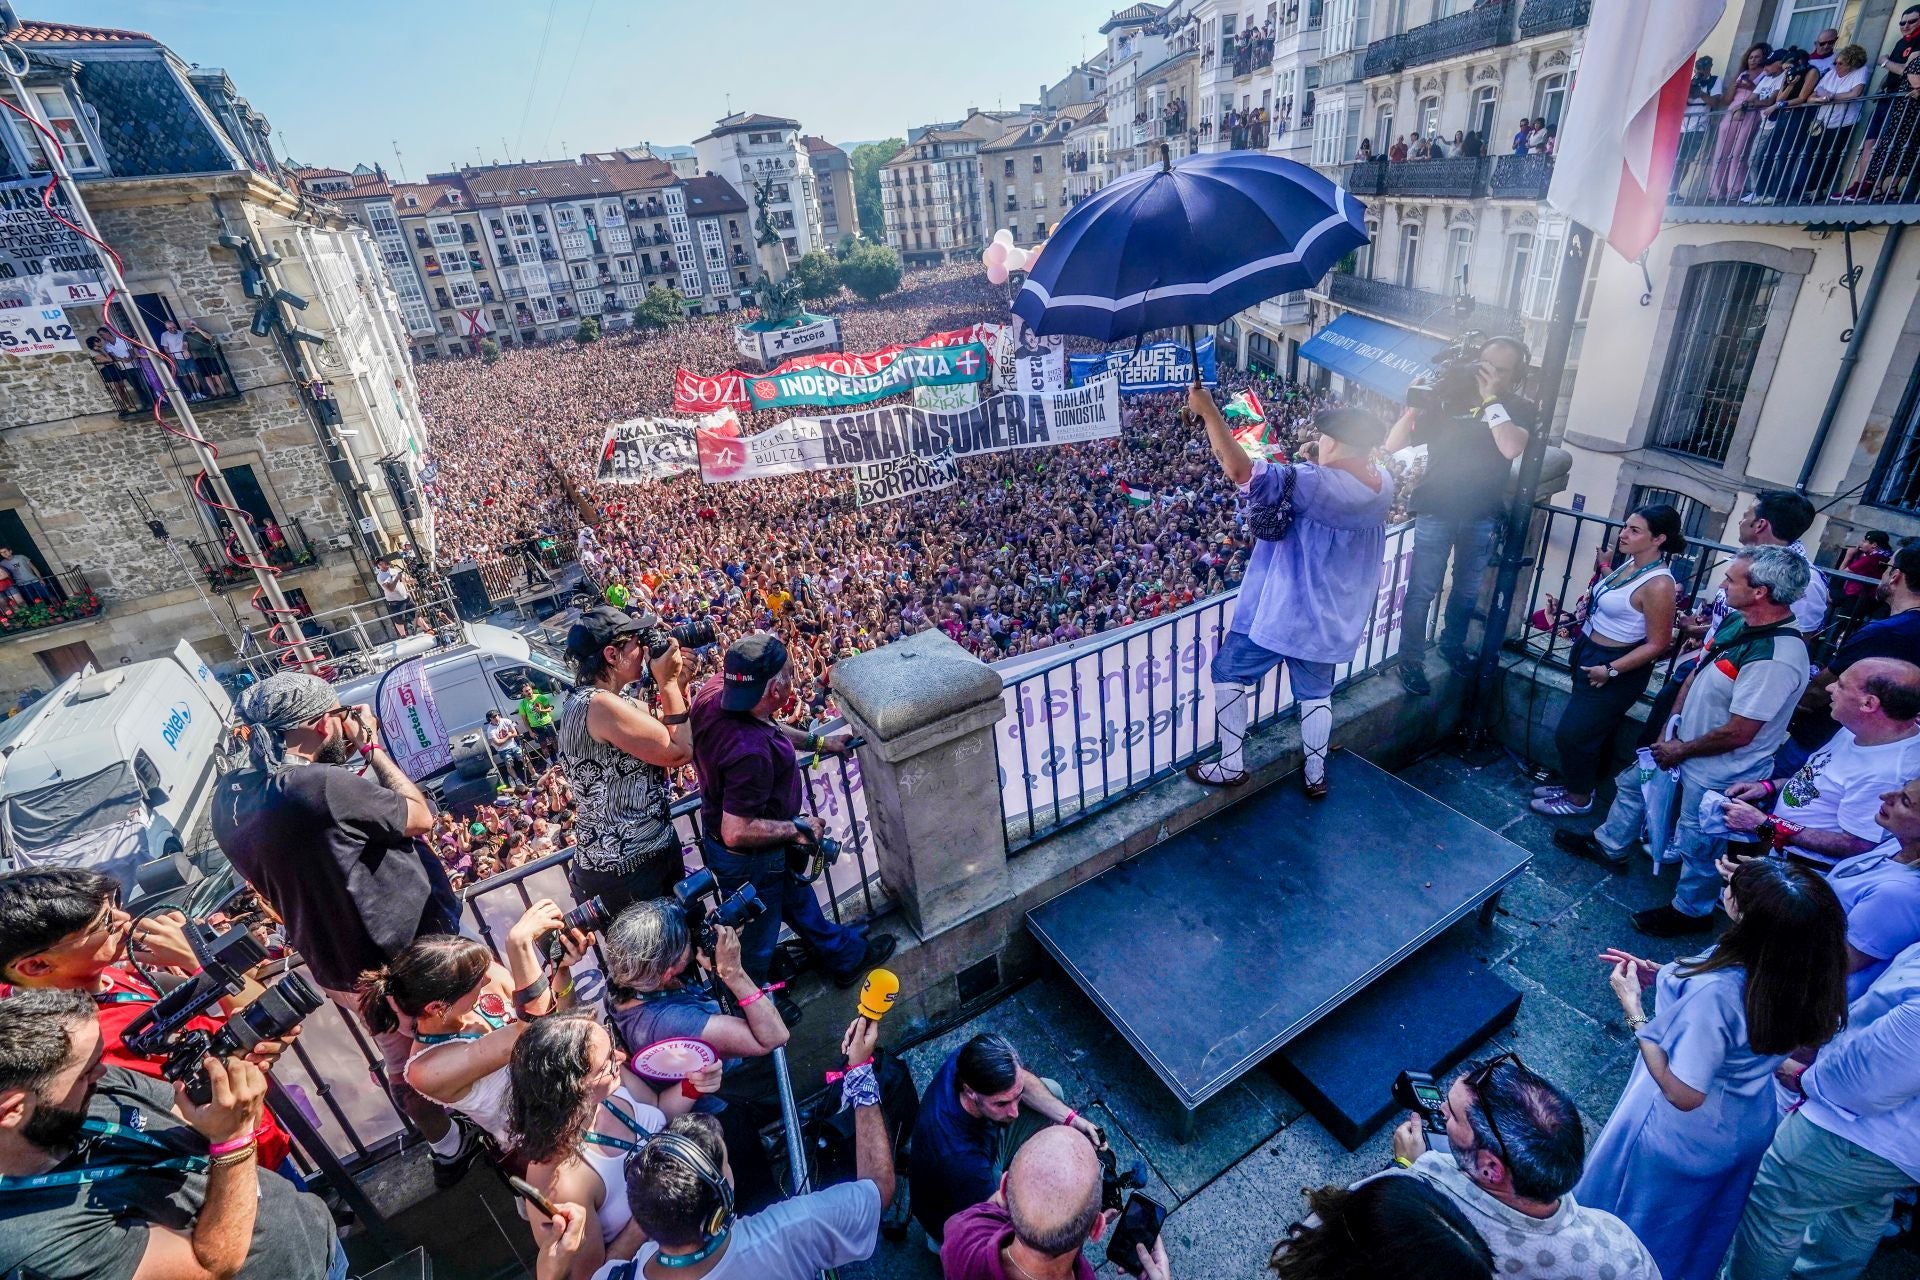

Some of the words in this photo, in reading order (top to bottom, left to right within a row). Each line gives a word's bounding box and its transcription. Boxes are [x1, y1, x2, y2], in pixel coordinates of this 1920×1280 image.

[10, 242, 80, 259] SOLDATA
[22, 260, 43, 276] LO
[41, 309, 62, 320] ILP
[793, 329, 825, 345] etxera
[1354, 342, 1383, 360] VIRGEN
[1380, 352, 1420, 375] BLANCA
[779, 355, 952, 398] INDEPENDENTZIA
[1053, 388, 1092, 410] IRAILAK
[1094, 383, 1105, 401] 14
[1054, 403, 1106, 428] DONOSTIA
[820, 393, 1049, 465] ASKATASUNERA
[754, 449, 804, 464] BULTZA
[162, 708, 186, 751] pixel
